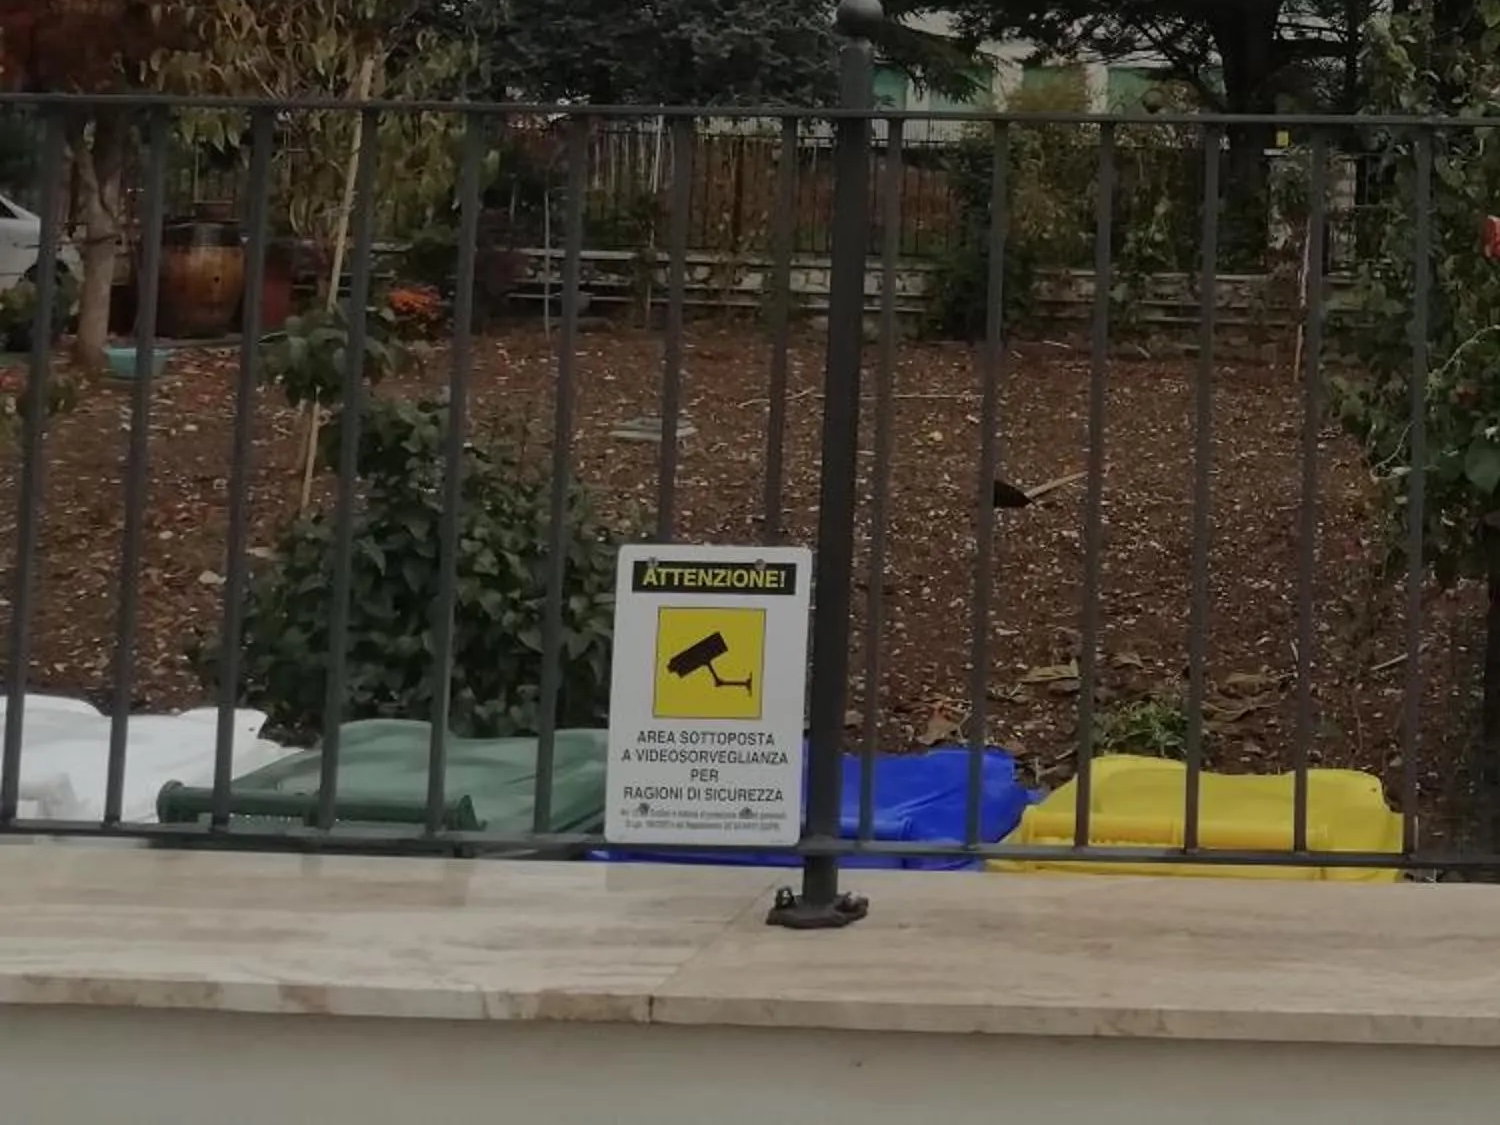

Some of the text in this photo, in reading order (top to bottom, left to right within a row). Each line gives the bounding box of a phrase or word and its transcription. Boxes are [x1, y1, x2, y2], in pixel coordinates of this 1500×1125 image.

[642, 567, 786, 588] ATTENZIONE!
[637, 730, 775, 746] AREA SOTTOPOSTA
[621, 749, 788, 765] A VIDEOSORVEGLIANZA
[690, 768, 719, 782] PER
[623, 786, 784, 803] RAGIONI DI SICUREZZA
